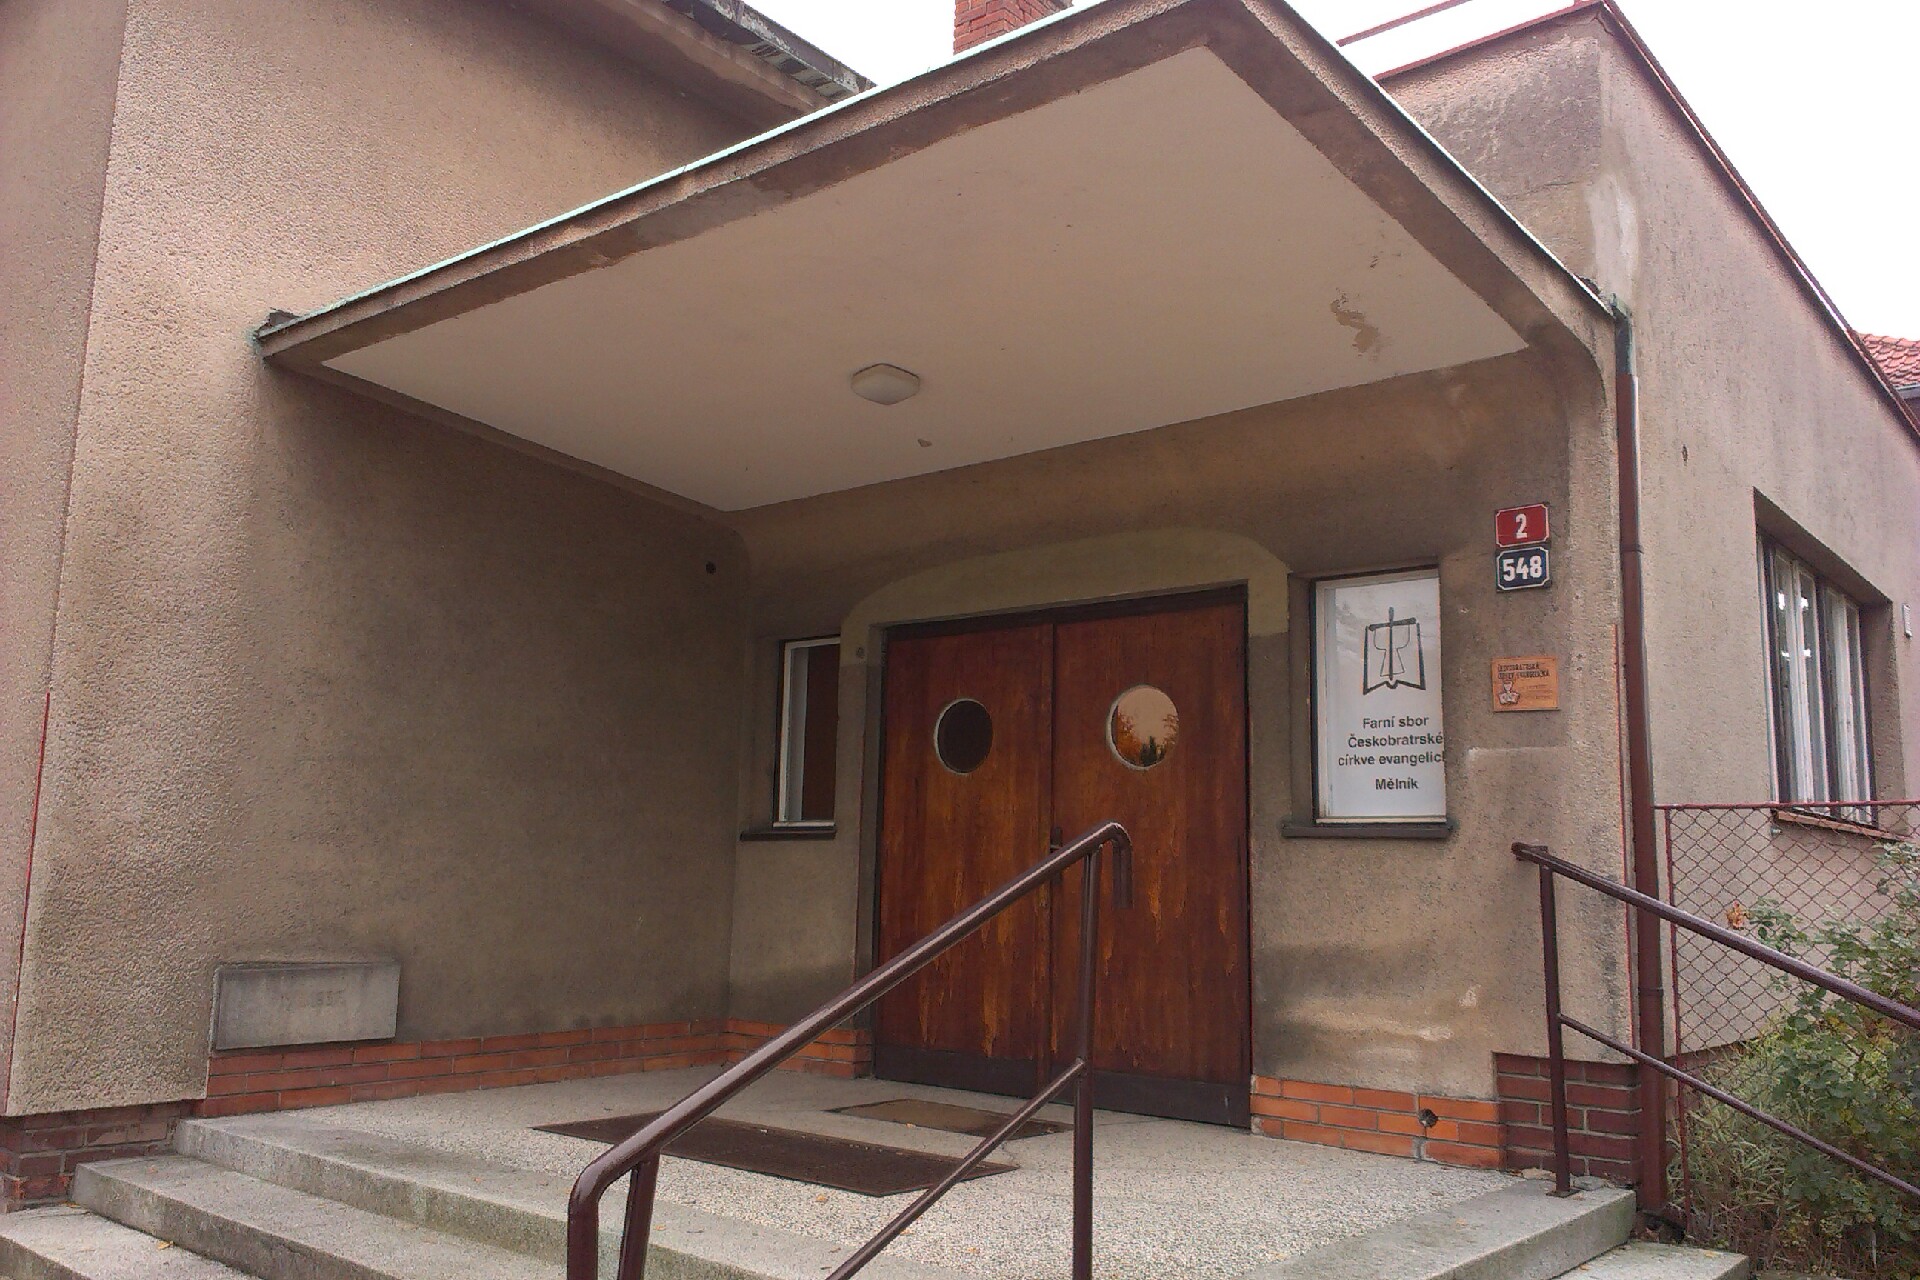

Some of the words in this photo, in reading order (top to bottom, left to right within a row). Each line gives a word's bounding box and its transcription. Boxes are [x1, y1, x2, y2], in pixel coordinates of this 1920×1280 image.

[1515, 513, 1528, 539] 2
[1502, 555, 1543, 582] 548
[1362, 716, 1395, 729] Farní
[1398, 716, 1429, 728] sbor
[1348, 732, 1443, 748] Českobratrské
[1338, 753, 1375, 766] církve
[1379, 751, 1445, 767] evangelic
[1375, 777, 1419, 790] Mělník
